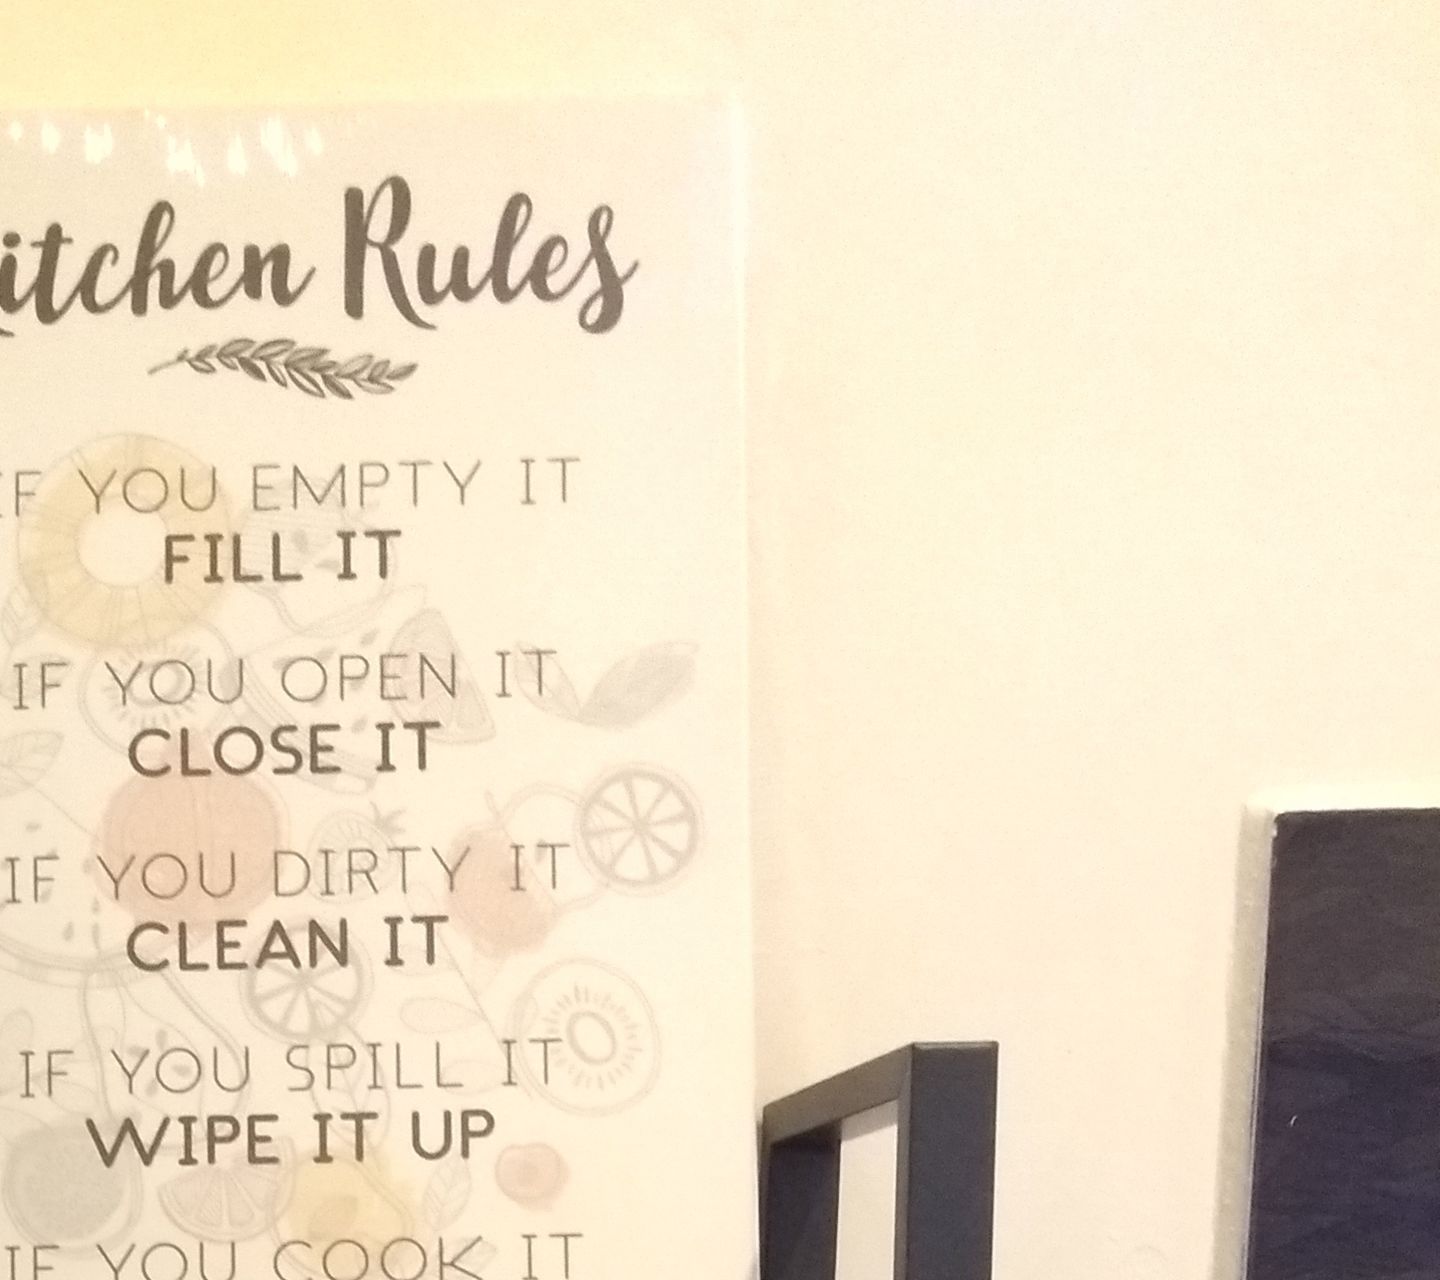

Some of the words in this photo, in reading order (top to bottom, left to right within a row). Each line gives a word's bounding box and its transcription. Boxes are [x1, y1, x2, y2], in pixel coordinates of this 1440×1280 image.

[341, 174, 640, 336] Rules
[77, 464, 221, 515] YOU
[251, 460, 481, 512] EMPTY
[518, 456, 581, 506] IT
[162, 532, 304, 584] FILL
[336, 530, 402, 580] IT
[11, 662, 69, 711] IF
[104, 657, 246, 706] YOU
[280, 652, 458, 701] OPEN
[496, 648, 558, 698] IT
[127, 724, 340, 777] CLOSE
[374, 722, 442, 771] IT
[3, 855, 59, 904] IF
[98, 850, 239, 900] YOU
[272, 846, 473, 898] DIRTY
[508, 842, 571, 892] IT
[125, 920, 350, 972] CLEAN
[383, 915, 449, 966] IT
[17, 1050, 74, 1099] IF
[112, 1046, 251, 1094] YOU
[286, 1042, 464, 1091] SPILL
[500, 1037, 563, 1086] IT
[85, 1114, 280, 1168] WIPE
[312, 1112, 378, 1161] IT
[412, 1108, 496, 1160] UP
[520, 1233, 584, 1280] IT
